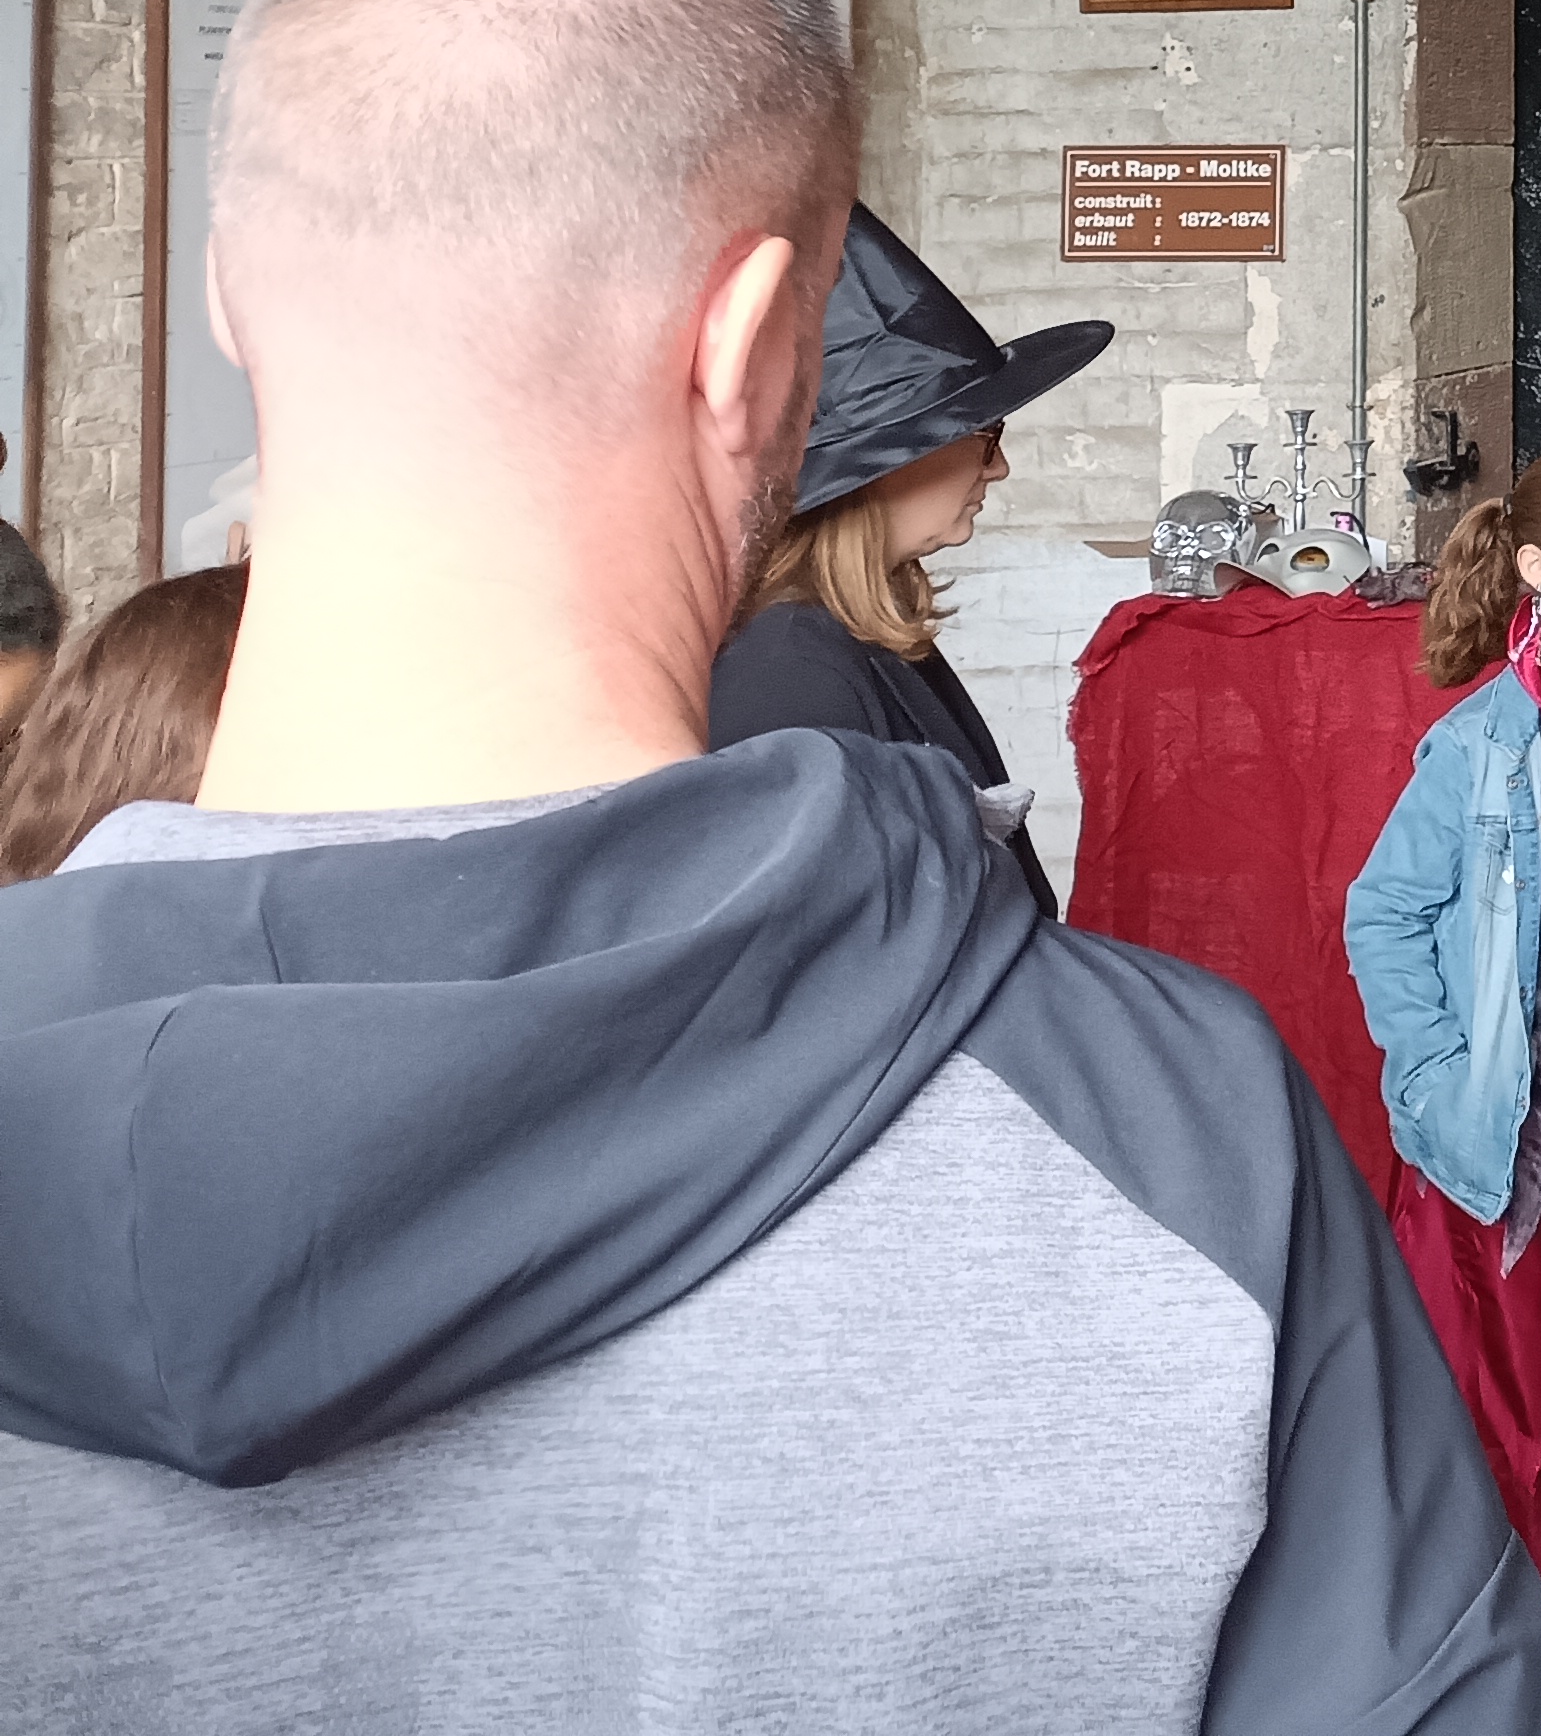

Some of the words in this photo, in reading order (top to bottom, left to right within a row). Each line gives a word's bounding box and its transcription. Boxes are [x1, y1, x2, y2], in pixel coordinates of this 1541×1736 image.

[1074, 160, 1120, 178] Fort
[1125, 160, 1181, 181] Rapp
[1186, 166, 1195, 174] -
[1199, 159, 1272, 178] Moltke
[1074, 213, 1135, 228] erbaut
[1178, 212, 1271, 228] 1872-1874
[1073, 231, 1117, 247] built
